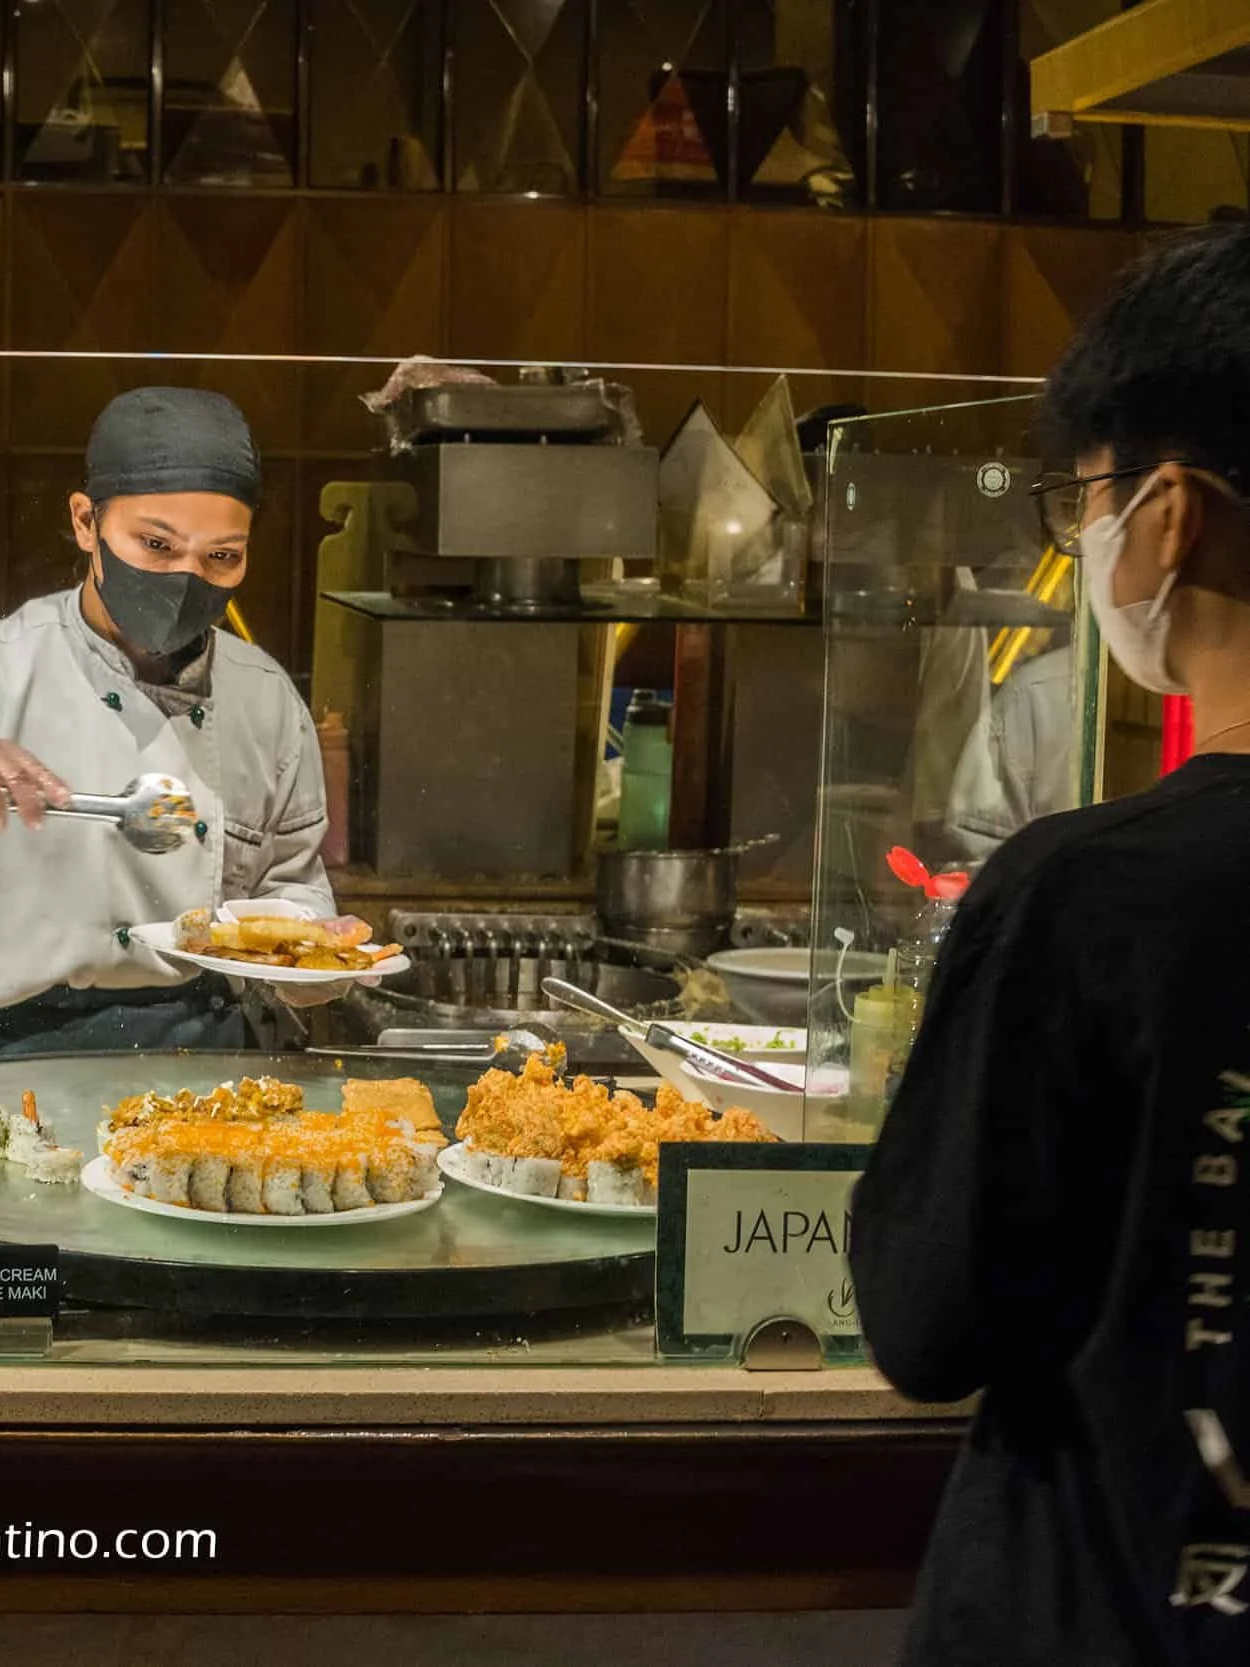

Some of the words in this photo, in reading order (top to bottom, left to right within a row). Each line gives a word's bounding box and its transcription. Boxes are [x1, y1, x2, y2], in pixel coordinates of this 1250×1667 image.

[0, 1268, 57, 1282] CREAM
[8, 1286, 47, 1300] MAKI
[1186, 1229, 1234, 1351] THE
